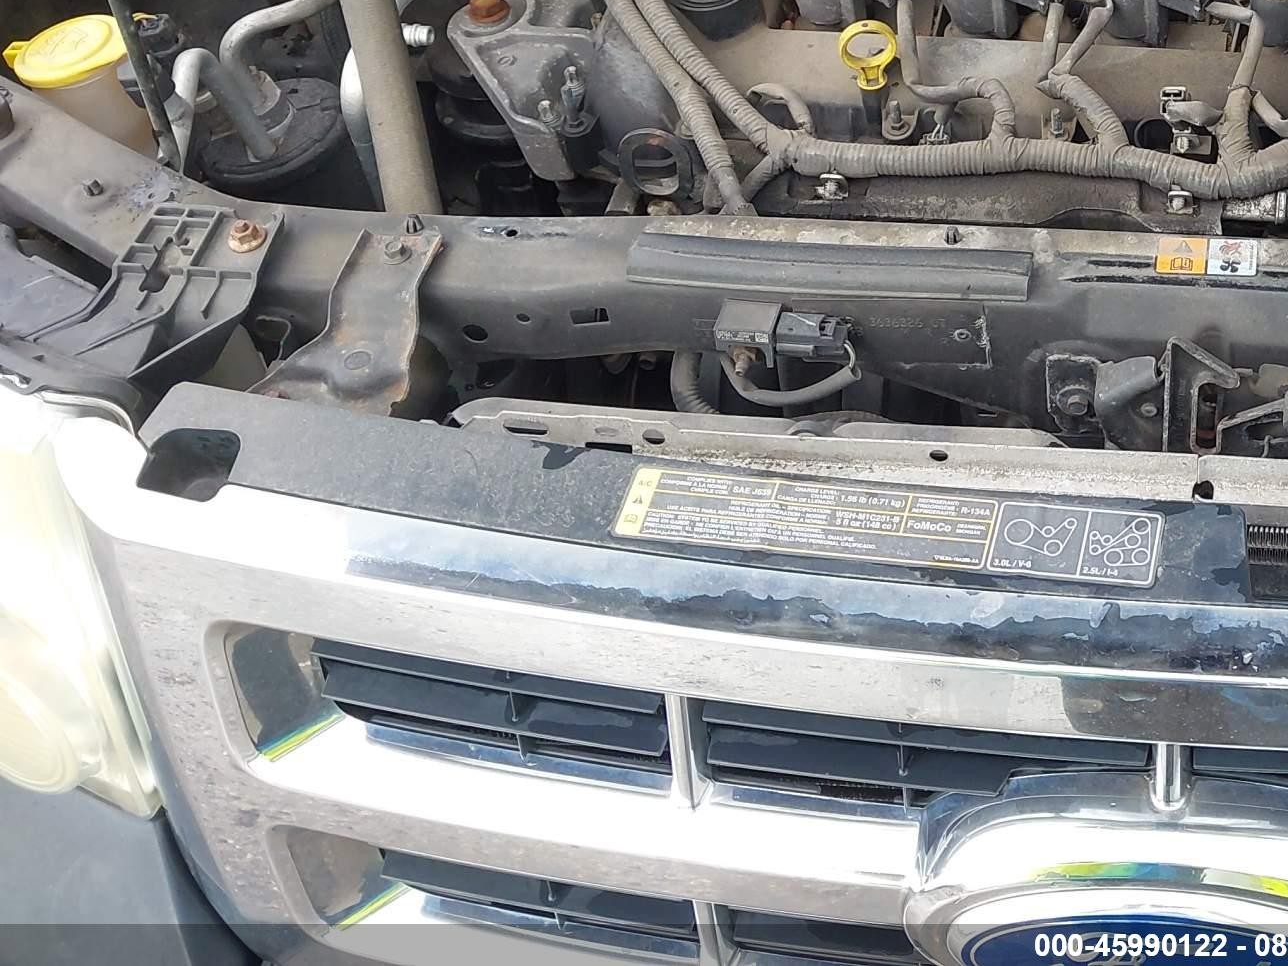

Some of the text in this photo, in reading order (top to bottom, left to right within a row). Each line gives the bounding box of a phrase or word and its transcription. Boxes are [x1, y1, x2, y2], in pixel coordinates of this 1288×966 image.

[732, 486, 751, 494] SAE
[890, 499, 905, 507] kg)
[960, 507, 990, 516] R-134A
[906, 520, 952, 532] FoMoCo
[1083, 567, 1100, 575] 2.5L
